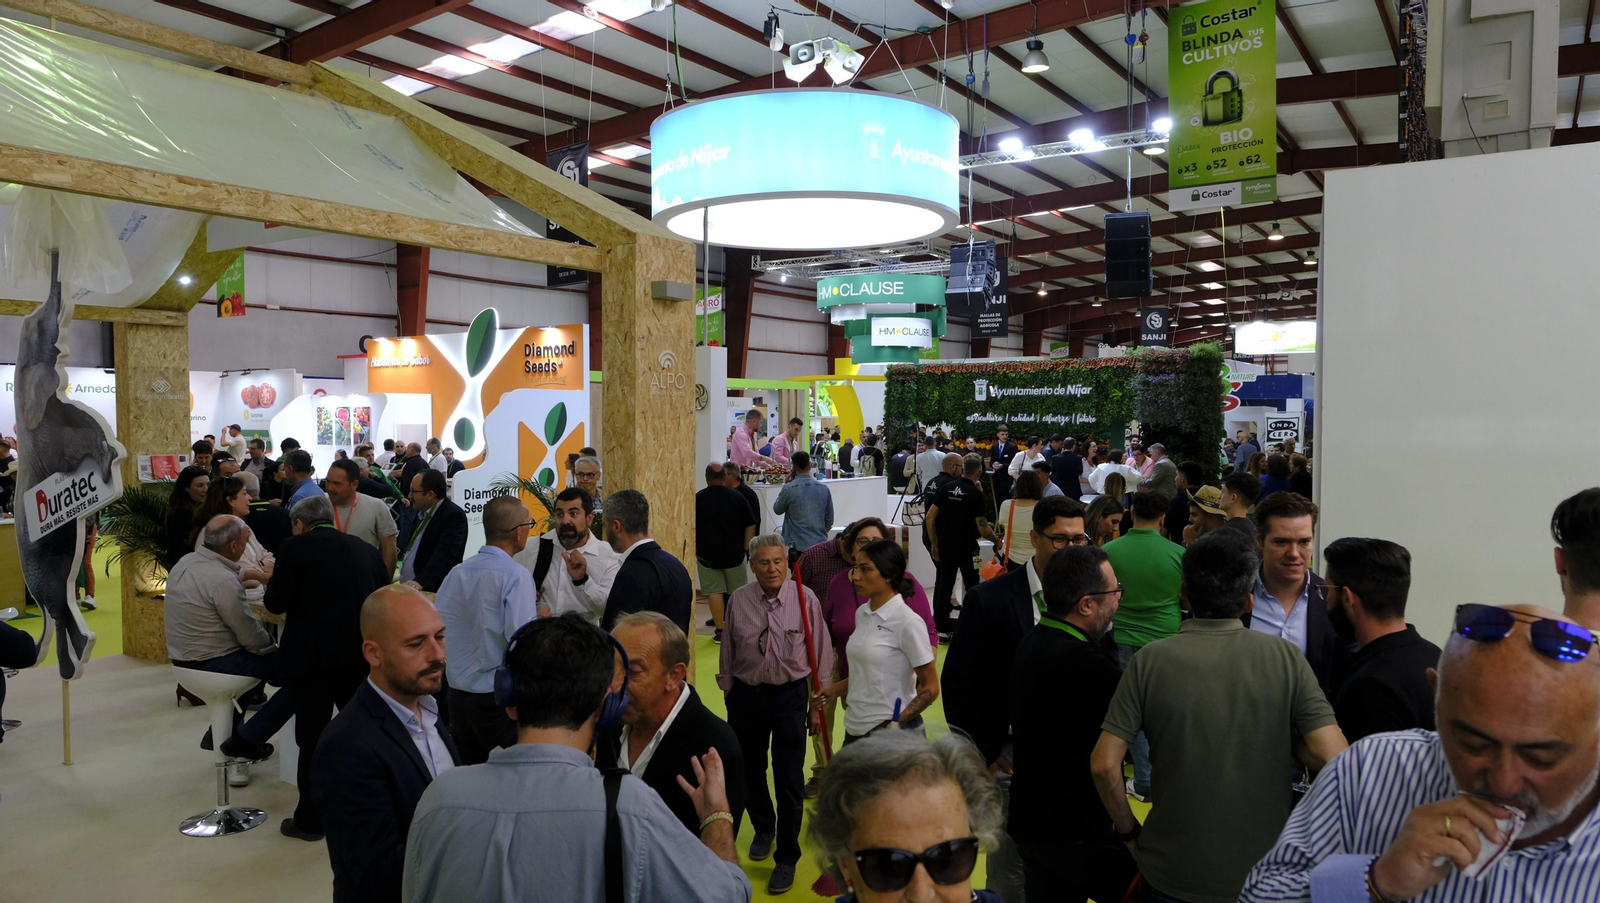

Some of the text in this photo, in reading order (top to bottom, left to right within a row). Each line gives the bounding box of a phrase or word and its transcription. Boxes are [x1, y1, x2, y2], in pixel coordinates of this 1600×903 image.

[1200, 6, 1257, 28] Costar
[1182, 27, 1264, 52] BLINDA TUS
[1182, 36, 1263, 65] CULTIVOS
[1220, 127, 1253, 145] BIO
[1211, 138, 1264, 154] PROTECCIÓN
[675, 148, 689, 170] de
[1213, 158, 1227, 169] 52
[1246, 153, 1261, 165] 62
[1184, 162, 1198, 173] x3
[1201, 189, 1233, 199] Costar
[819, 281, 904, 300] HM CLAUSE
[879, 327, 930, 337] HM CLAUSE
[1141, 333, 1167, 341] SANJI
[524, 341, 575, 358] Diamond
[524, 359, 558, 373] Seeds
[650, 372, 687, 390] ALPO
[993, 384, 1092, 398] Ayuntamiento de Níjar
[1010, 413, 1036, 422] calidad
[35, 471, 97, 524] Duratec
[40, 522, 54, 534] DURA
[66, 502, 87, 519] RESISTE
[87, 494, 99, 506] MÁS
